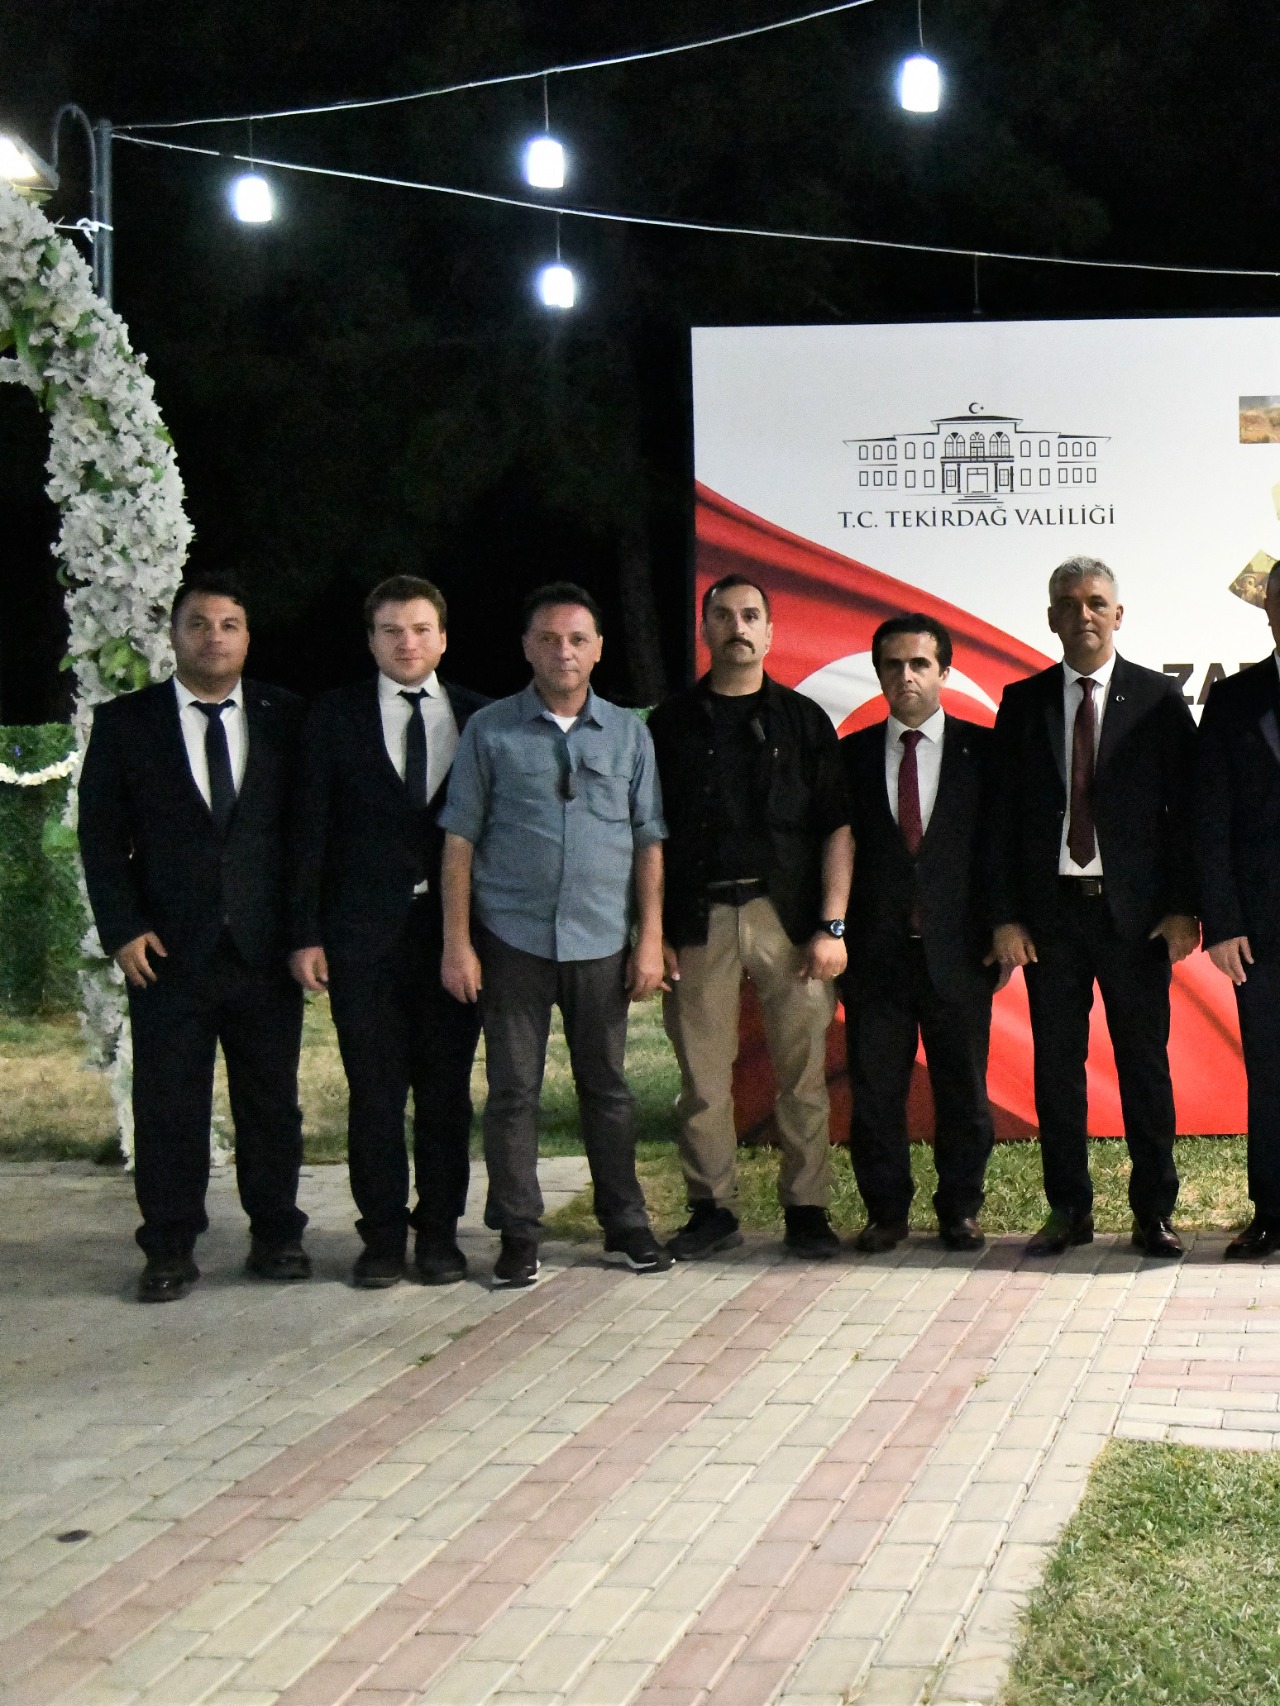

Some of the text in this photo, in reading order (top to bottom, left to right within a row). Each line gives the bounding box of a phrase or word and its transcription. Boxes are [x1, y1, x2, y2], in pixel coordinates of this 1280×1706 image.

[838, 503, 1116, 529] T.C. TEKİRDAĞ VALİLİĞİ
